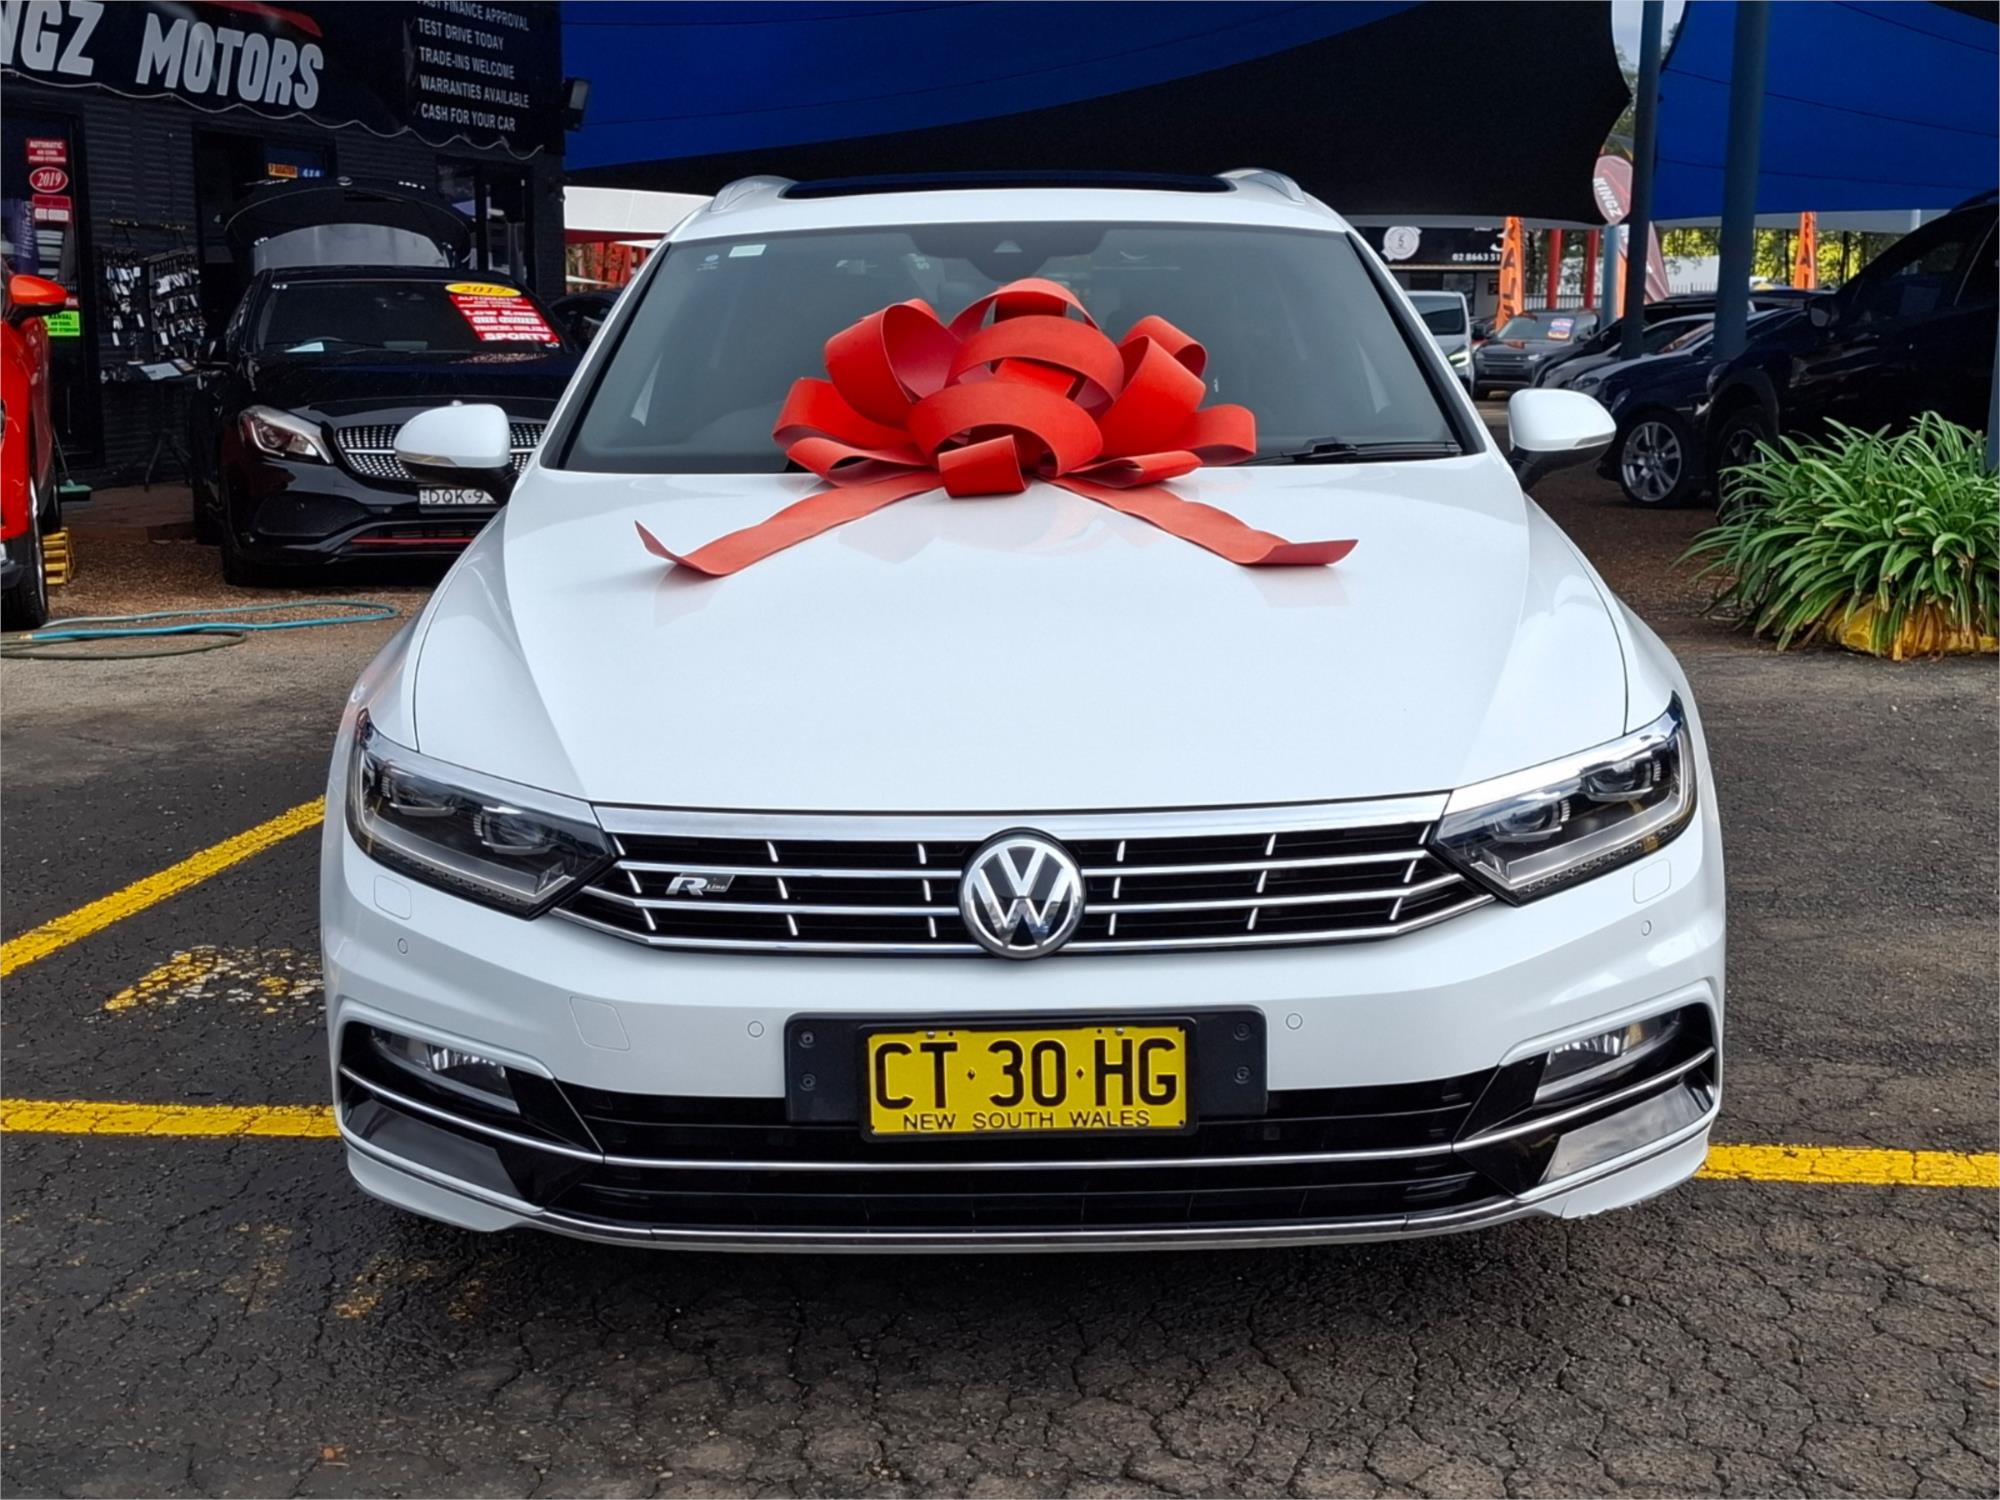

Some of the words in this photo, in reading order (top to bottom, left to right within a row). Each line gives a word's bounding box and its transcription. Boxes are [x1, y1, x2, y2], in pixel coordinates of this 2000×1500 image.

[418, 18, 442, 37] TEST
[445, 24, 473, 44] DRIVE
[474, 31, 504, 50] TODAY
[485, 7, 530, 31] APPROVAL
[135, 12, 323, 109] MOTORS
[419, 46, 470, 71] TRADE-INS
[471, 57, 515, 80] WELCOME
[420, 74, 482, 100] WARRANTIES
[484, 87, 529, 108] AVAILABLE
[421, 103, 448, 121] CASH
[450, 108, 470, 124] FOR
[471, 111, 496, 129] YOUR
[497, 115, 516, 131] CAR
[37, 172, 62, 187] 2019
[1593, 177, 1624, 218] KINGZ
[482, 332, 551, 341] SPORTY
[665, 876, 707, 896] R
[875, 1042, 958, 1109] CT
[988, 1040, 1067, 1107] 30
[1094, 1038, 1177, 1106] HG
[903, 1113, 956, 1130] NEW
[972, 1111, 1054, 1129] SOUTH
[1069, 1110, 1149, 1127] WALES
